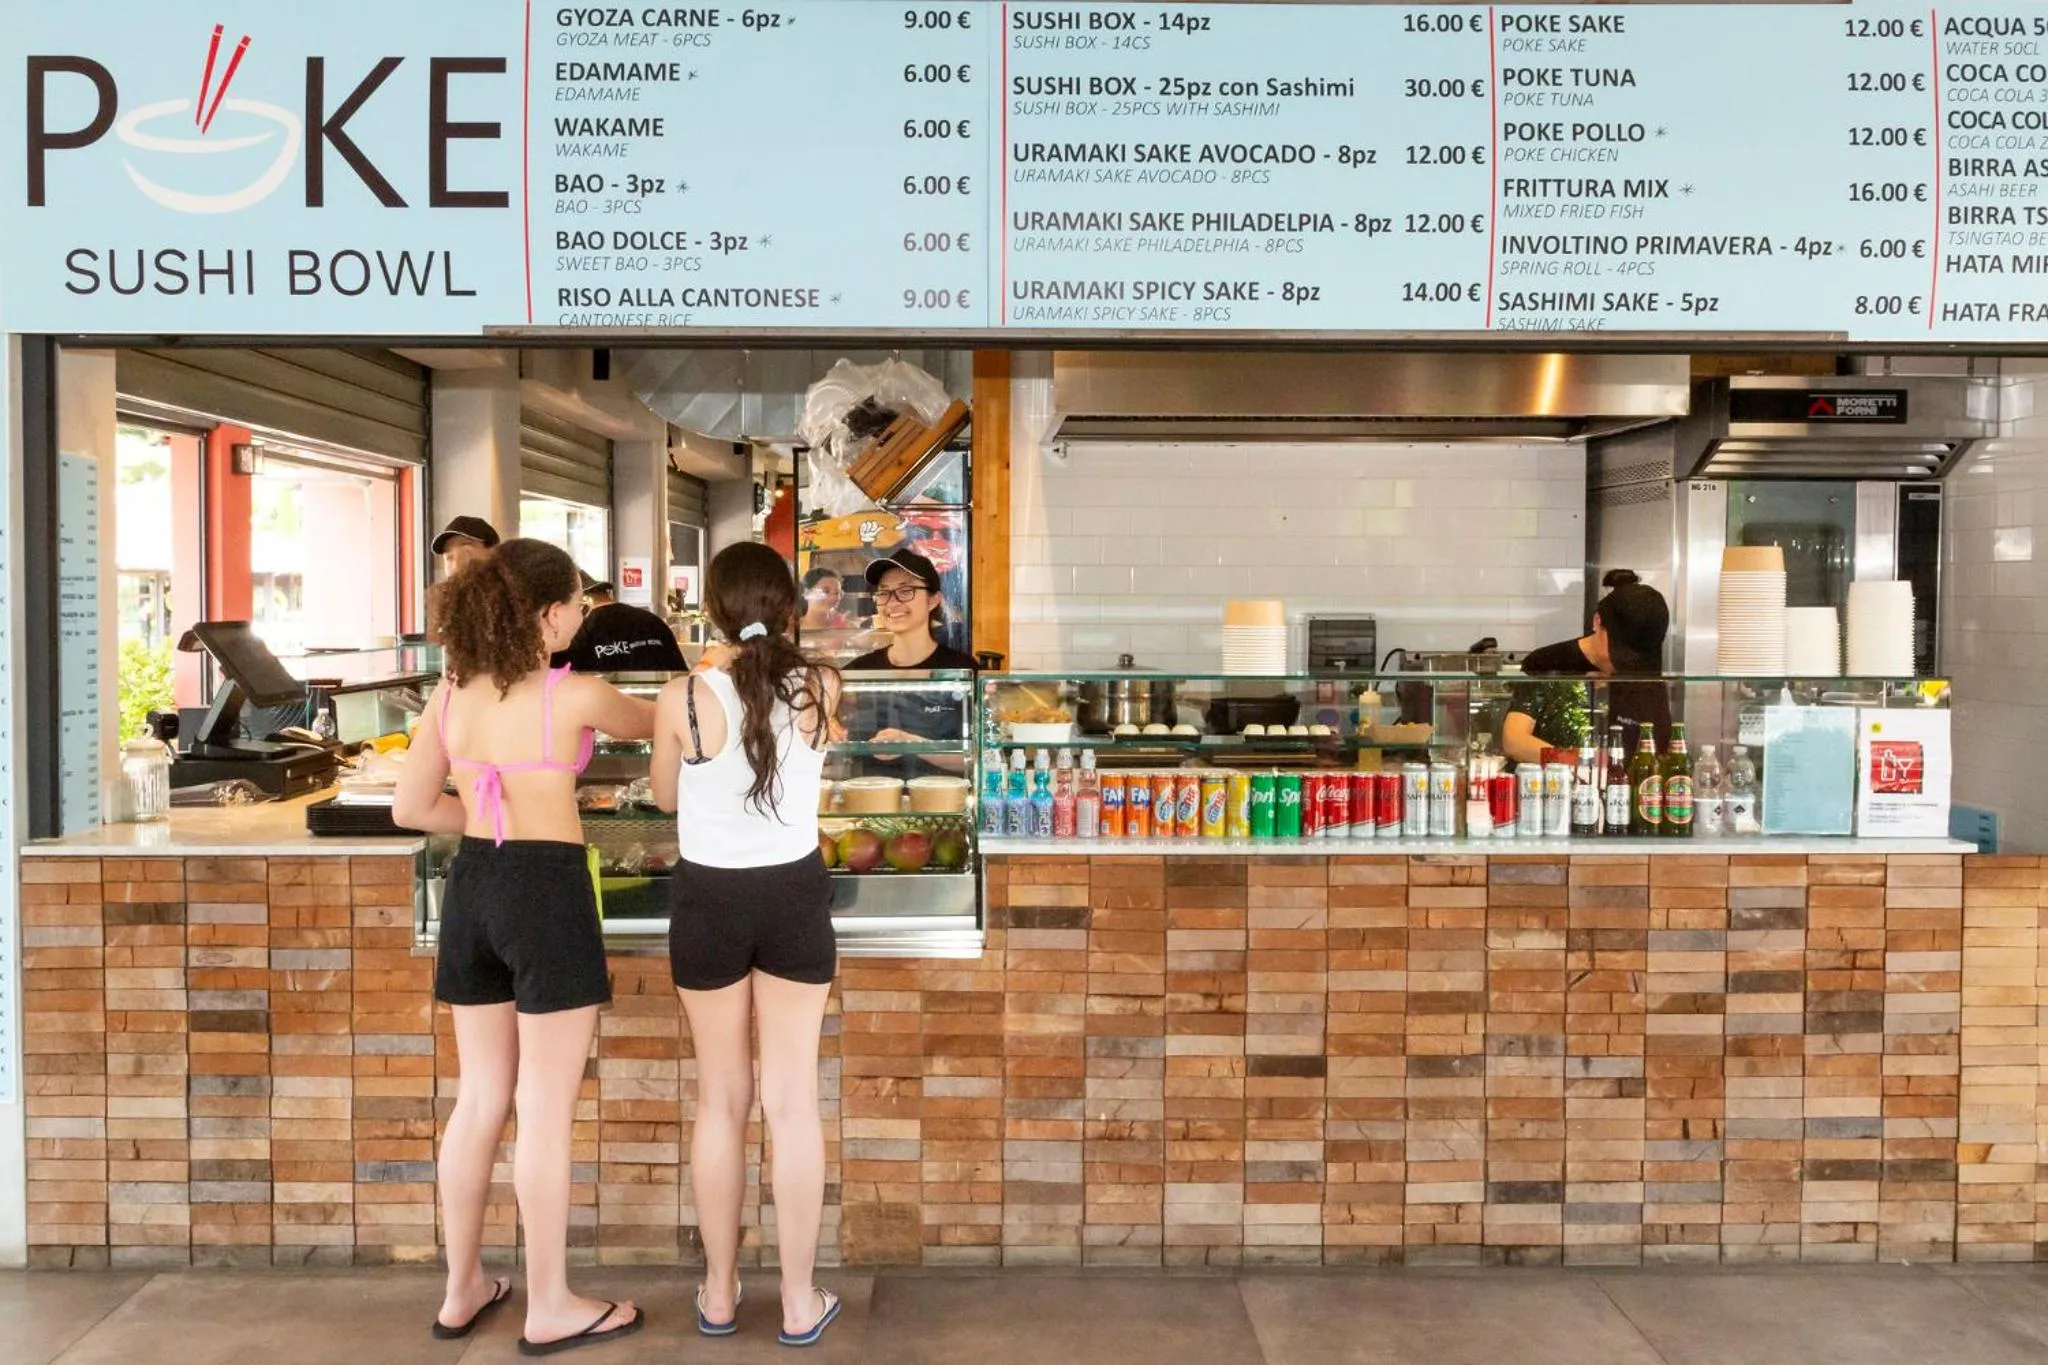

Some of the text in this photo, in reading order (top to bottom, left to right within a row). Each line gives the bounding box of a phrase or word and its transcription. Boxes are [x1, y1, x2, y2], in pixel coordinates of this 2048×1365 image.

[557, 8, 951, 32] GYOZA CARNE 6pz 9.00
[1013, 12, 1463, 34] SUSHI BOX 14pz 16.00
[1502, 15, 1904, 37] POKE SAKE 12.00
[1944, 17, 2048, 38] ACQUA 5
[557, 32, 710, 47] GYOZA MEAT 6PCS
[1014, 35, 1151, 49] SUSHI BOX 14CS
[1503, 38, 1586, 52] POKE SAKE
[1947, 40, 2039, 56] WATER 50CL
[556, 63, 951, 82] EDAMAME 6.00
[1503, 68, 1906, 91] POKE TUNA 12.00
[1946, 64, 2008, 82] COCA
[556, 87, 640, 101] EDAMAME
[1013, 76, 1465, 100] SUSHI BOX 25pz con Sashimi 30.00
[1947, 88, 1989, 102] COCA
[1994, 88, 2034, 103] COLA
[1504, 92, 1593, 106] POKE TUNA
[1014, 101, 1280, 116] SUSHI BOX 25PCS WITH SASHIMI
[555, 118, 951, 138] WAKAME 6.00
[1948, 110, 2006, 129] COCA
[1504, 123, 1908, 146] POKE POLLO 12.00
[1948, 135, 1990, 149] COCA
[1996, 135, 2035, 149] COLA
[556, 143, 628, 157] WAKAME
[1013, 143, 1465, 169] URAMAKI SAKE AVOCADO 8pz 12.00
[1504, 147, 1618, 162] POKE CHICKEN
[1014, 168, 1270, 184] URAMAKI SAKE AVOCADO 8PCS
[1949, 158, 2017, 177] BIRRA
[556, 174, 951, 198] BAO 3pz 6.00
[1504, 179, 1908, 202] FRITTURA MIX 16.00
[1947, 183, 2038, 197] ASAHI BEER
[555, 199, 642, 214] BAO 3PCS
[1504, 204, 1644, 219] MIXED FRIED FISH
[1949, 206, 2016, 225] BIRRA
[1014, 212, 1464, 236] URAMAKI SAKE PHILADELPIA 8pz 12.00
[557, 231, 951, 255] BAO DOLCE 3pz 6.00
[1014, 237, 1304, 253] URAMAKI SAKE PHILADELPHIA 8PCS
[1949, 231, 2024, 245] TSINGTAO
[1502, 236, 1906, 259] INVOLTINO PRIMAVERA 4pz 6.00
[65, 248, 477, 296] SUSHI BOWL
[557, 256, 702, 271] SWEET BAO 3PCS
[1500, 260, 1656, 276] SPRING ROLL 4PCS
[1946, 255, 2003, 273] HATA
[558, 288, 950, 308] RISO ALLA CANTONESE 9.00
[1014, 281, 1461, 305] URAMAKI SPICY SAKE 8pz 14.00
[1498, 292, 1902, 316] SASHIMI SAKE 5pz 8.00
[1943, 303, 2000, 321] HATA
[1014, 306, 1231, 321] URAMAKI SPICY SAKE 8PCS
[1836, 397, 1897, 406] MORETTI
